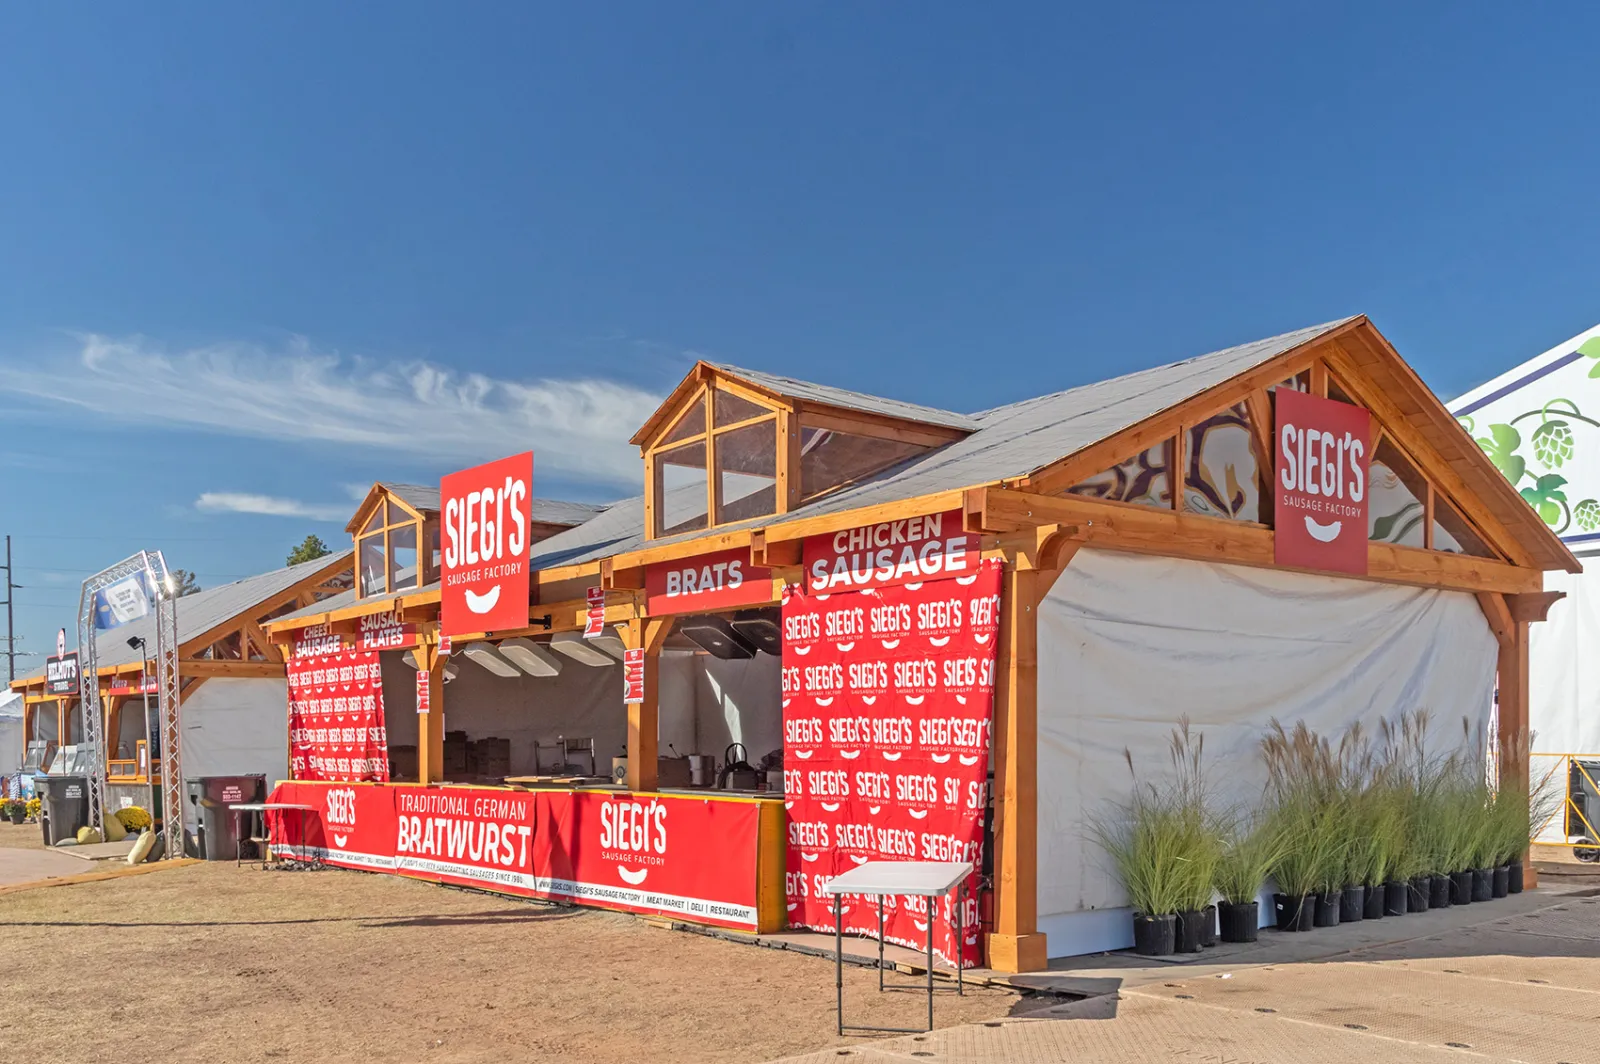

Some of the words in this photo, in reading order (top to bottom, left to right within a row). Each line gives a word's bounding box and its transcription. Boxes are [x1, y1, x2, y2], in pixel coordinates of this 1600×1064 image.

[1281, 424, 1364, 503] SIEGI'S
[1283, 495, 1322, 512] SAUSAGE
[1325, 503, 1361, 518] FACTORY
[445, 476, 526, 569] SIEGI'S
[833, 514, 943, 554] CHICKEN
[447, 569, 481, 586] SAUSAGE
[484, 562, 522, 580] FACTORY
[811, 536, 967, 591] SAUSAGE
[666, 560, 743, 597] BRATS
[786, 612, 820, 640] SIEGI'S
[826, 607, 864, 636] SIEGI'S
[870, 603, 911, 633] SIEGI'S
[918, 598, 962, 629] SIEGI'S
[304, 624, 327, 639] CHEES
[364, 627, 403, 649] PLATES
[296, 634, 340, 658] SAUSAGE
[782, 666, 800, 691] GI'S
[805, 663, 843, 690] SIEGI'S
[849, 660, 888, 689] SIEGI'S
[894, 658, 937, 687] SIEGI'S
[786, 717, 823, 743] SIEGI'S
[829, 716, 871, 742] SIEGI'S
[873, 716, 912, 744] SIEGI'S
[919, 716, 962, 745] SIEGI'S
[784, 769, 802, 794] GI'S
[808, 769, 850, 796] SIEGI'S
[896, 774, 937, 803] SIEGI'S
[327, 787, 356, 825] SIEGI'S
[401, 794, 469, 816] TRADITIONAL
[474, 798, 526, 821] GERMAN
[600, 800, 667, 854] SIEGI'S
[789, 821, 829, 847] SIEGI'S
[836, 823, 876, 850] SIEGI'S
[398, 815, 531, 868] BRATWURST
[877, 828, 916, 856] SIEGI'S
[602, 851, 632, 863] SAUSAGE
[634, 854, 665, 866] FACTORY
[469, 868, 494, 880] SAUSAGES
[495, 872, 510, 882] SINCE
[786, 871, 808, 897] GI'S
[575, 886, 594, 895] SIEGI'S
[594, 888, 618, 899] SAUSAGE
[619, 892, 641, 902] FACTORY
[647, 896, 662, 905] MEAT
[663, 898, 684, 909] MARKET
[691, 902, 704, 912] DELI
[710, 905, 750, 918] RESTAURANT
